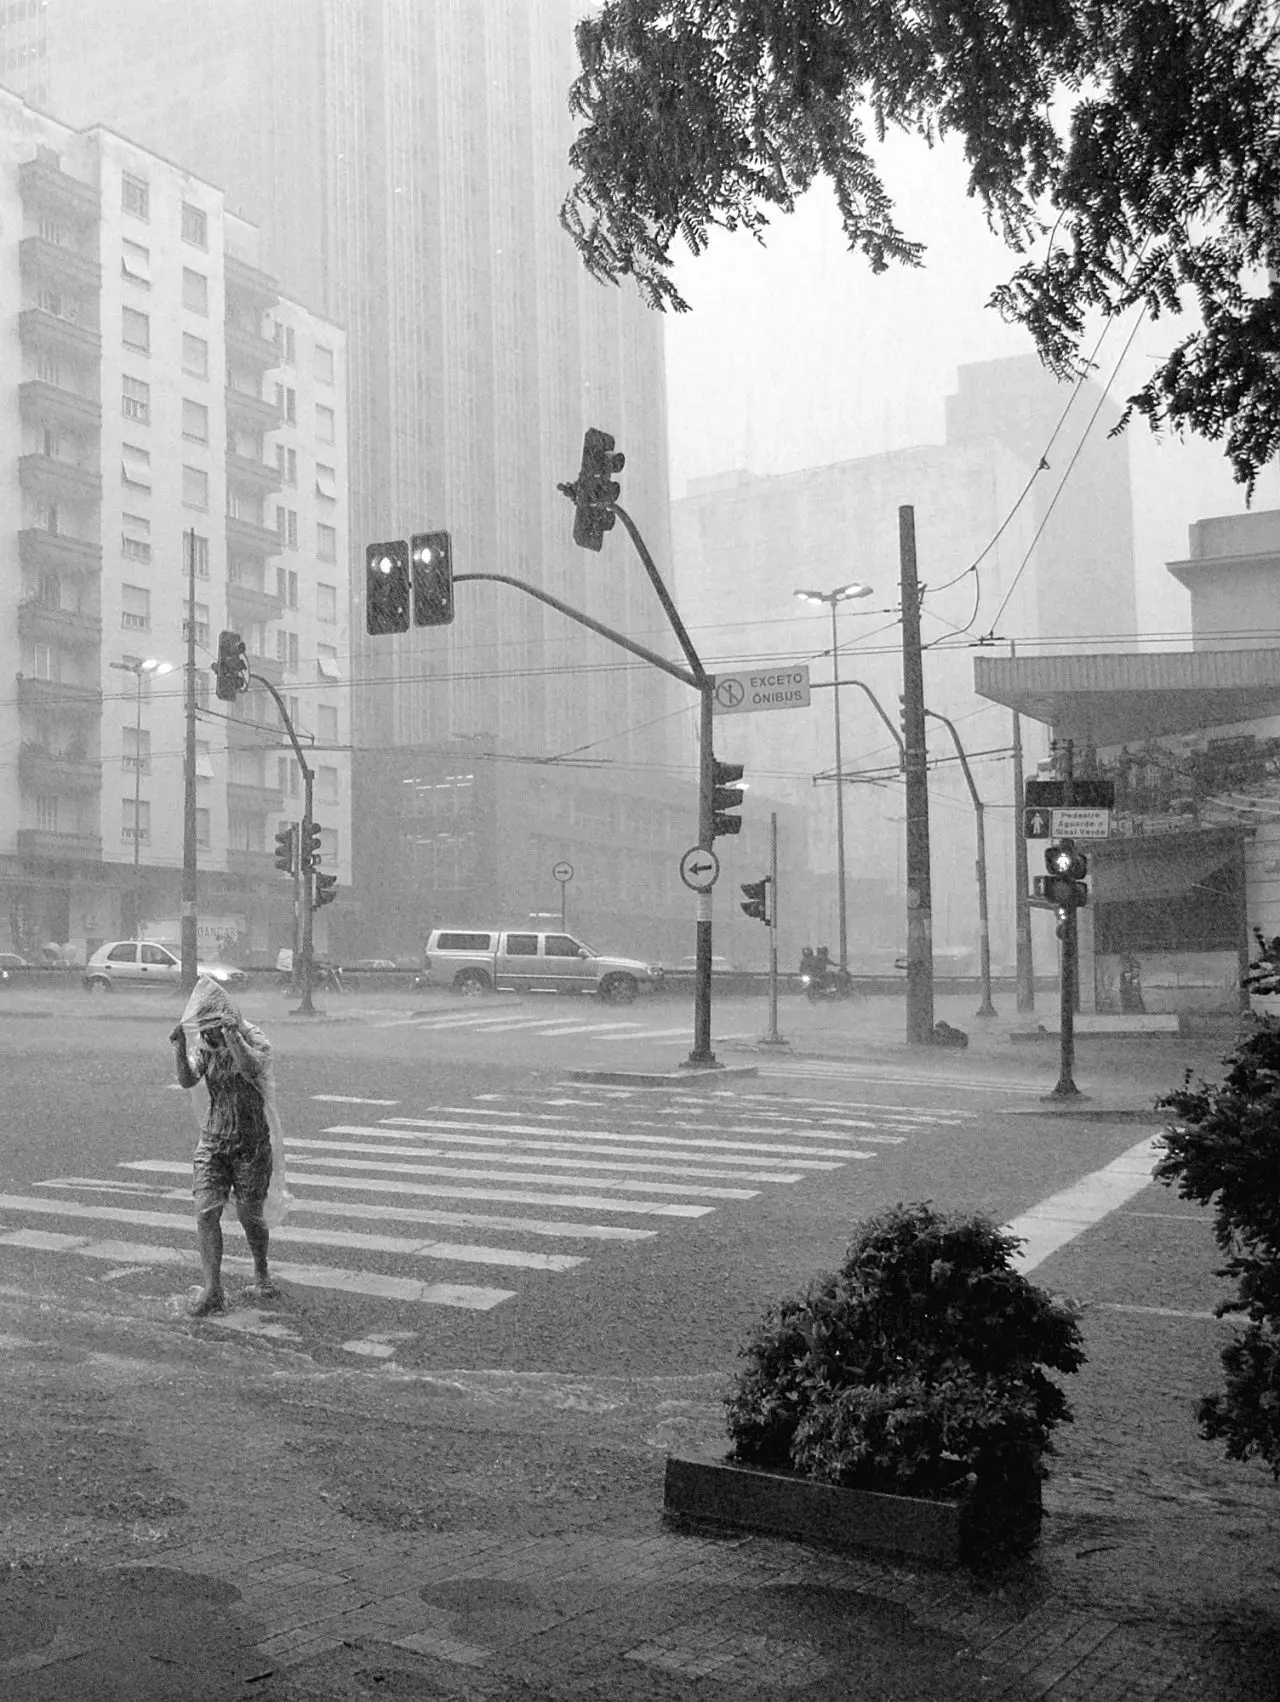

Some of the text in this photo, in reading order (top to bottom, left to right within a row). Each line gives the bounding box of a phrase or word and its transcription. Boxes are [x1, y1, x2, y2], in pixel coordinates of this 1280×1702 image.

[750, 673, 803, 688] EXCETO
[752, 690, 803, 704] ÔNIBUS
[1060, 811, 1101, 819] Pedestre
[1057, 819, 1095, 828] Aguarde
[1055, 827, 1106, 836] Sinal Verde
